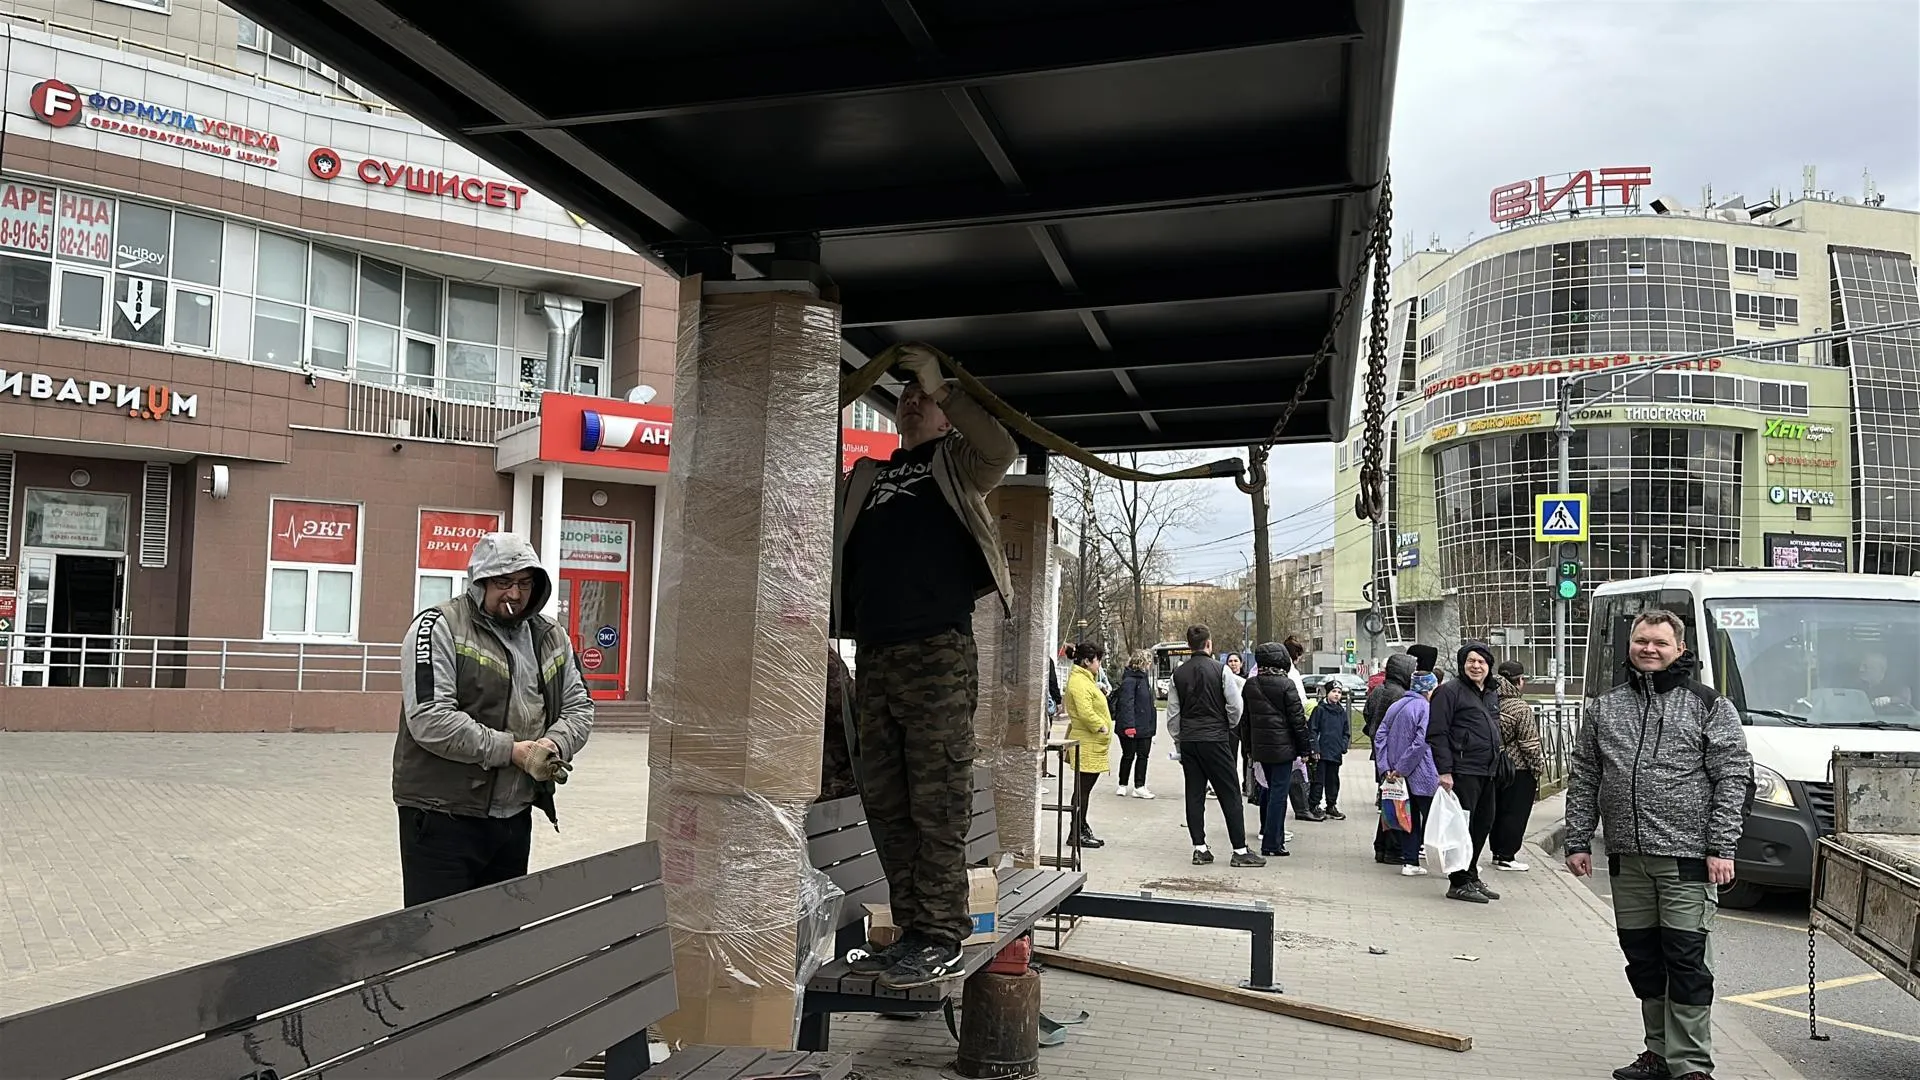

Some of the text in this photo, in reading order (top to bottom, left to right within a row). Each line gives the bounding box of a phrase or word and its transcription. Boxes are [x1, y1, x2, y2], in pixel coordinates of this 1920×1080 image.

[88, 92, 280, 152] ФОРМУЛА УСПЕХА
[90, 117, 277, 168] ОБРАЗОВАТЕЛЬНЫЙ ЦЕНТР
[357, 158, 529, 210] СУШИСЕТ
[1490, 166, 1651, 223] ВИТ
[133, 280, 144, 325] ВХОД
[1639, 355, 1722, 372] НТР
[1556, 409, 1612, 421] СТОРАН
[1625, 406, 1707, 421] ТИПОГРАФИЯ
[640, 426, 670, 447] АН
[1763, 417, 1807, 440] XFIT
[302, 519, 351, 538] ЭКГ
[432, 524, 488, 539] ВЫЗОВ
[426, 540, 468, 552] ВРАЧА
[1563, 563, 1576, 575] 37
[418, 619, 434, 636] DO
[599, 633, 615, 641] ЭКГ
[416, 636, 431, 665] JUST
